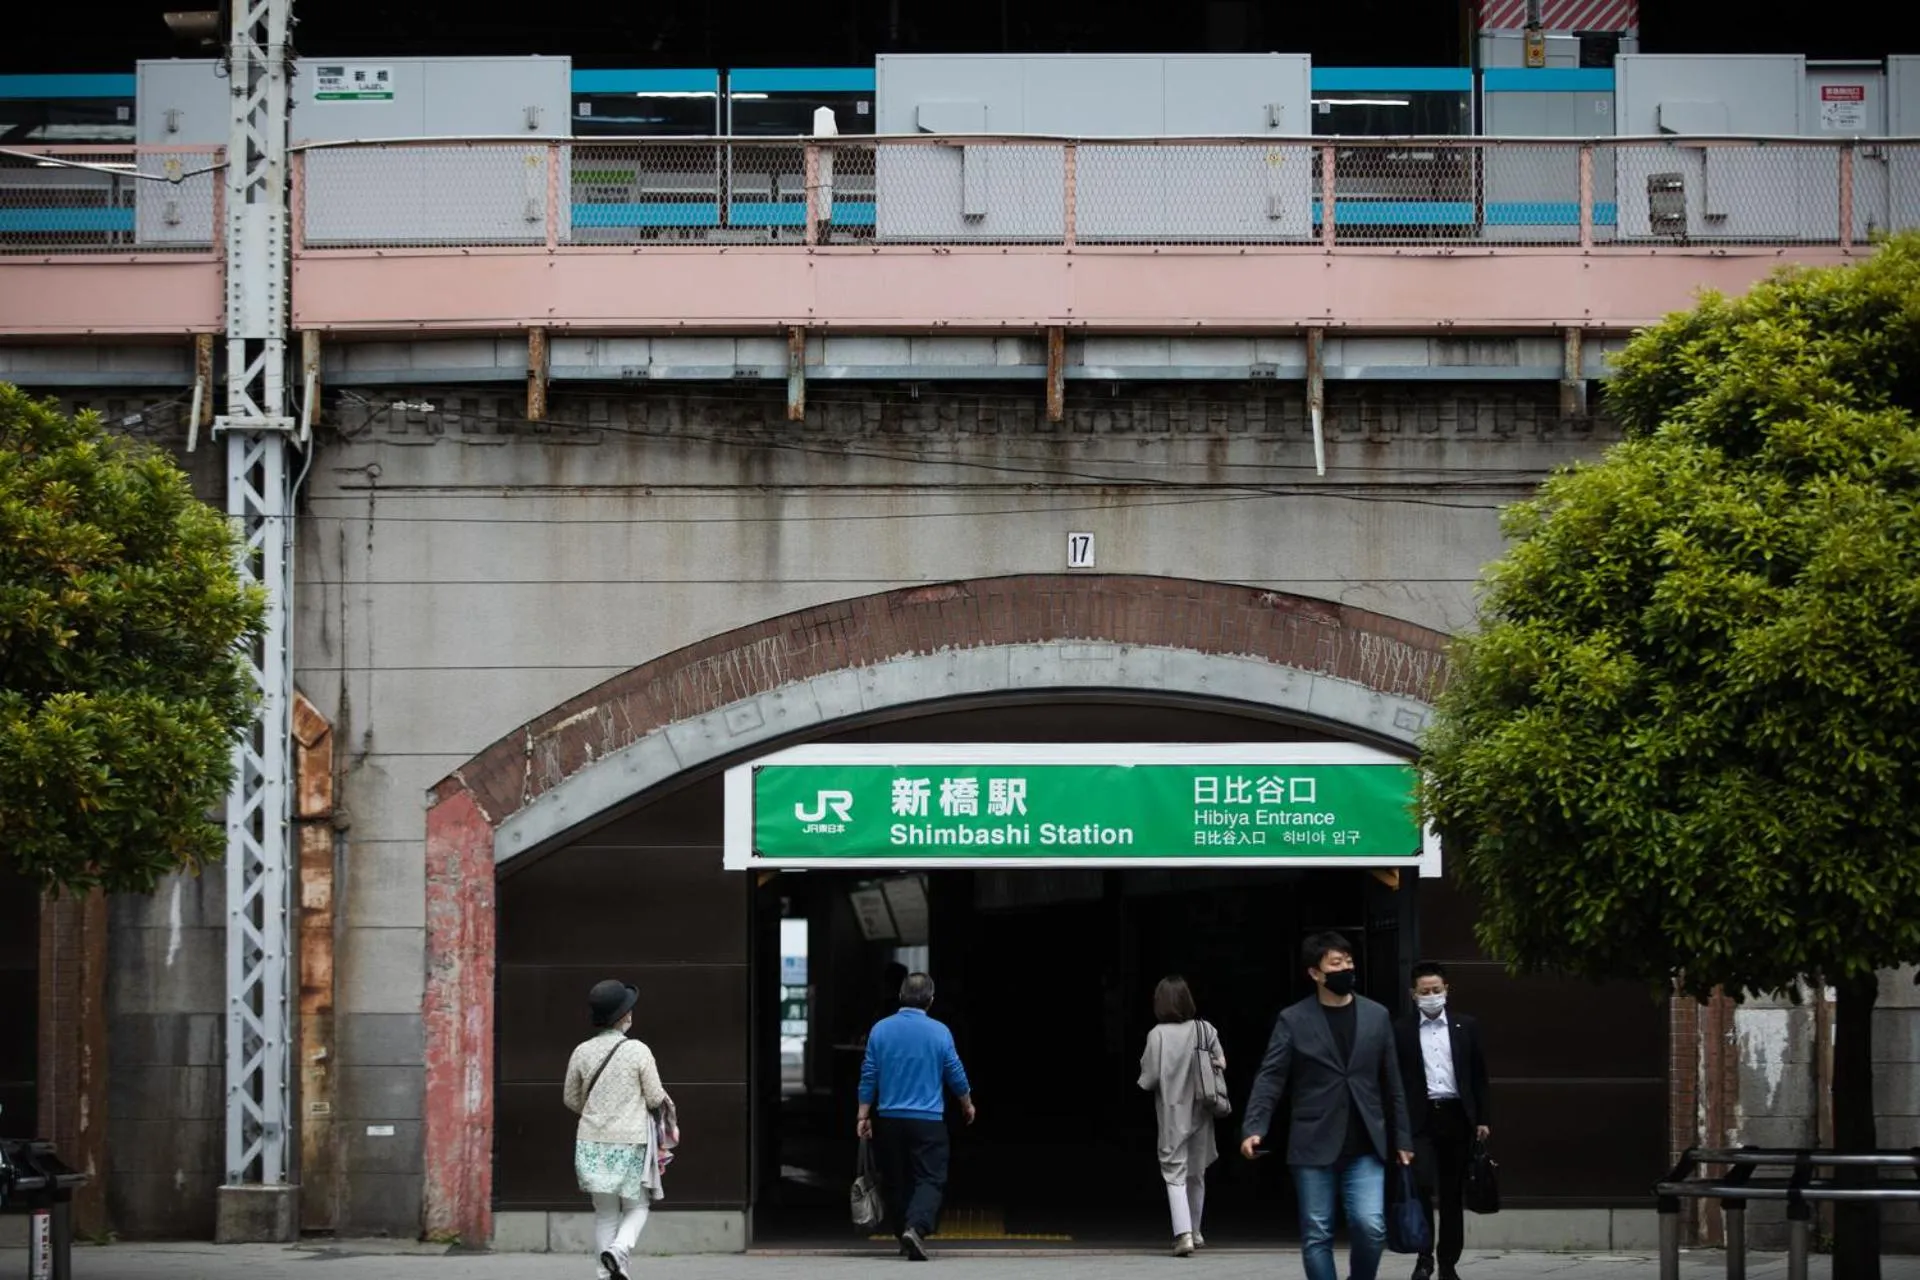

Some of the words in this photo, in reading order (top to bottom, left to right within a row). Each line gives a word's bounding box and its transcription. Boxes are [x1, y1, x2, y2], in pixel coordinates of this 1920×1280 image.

[1071, 536, 1090, 563] 17
[891, 777, 1027, 817] 新橋駅
[1194, 775, 1316, 804] 日比谷口
[794, 790, 854, 822] JR
[1194, 809, 1250, 829] Hibiya
[1255, 809, 1335, 826] Entrance
[890, 823, 1030, 845] Shimbashi
[1039, 823, 1133, 845] Station
[1194, 830, 1266, 845] 日比谷入口
[1332, 830, 1361, 845] 입구
